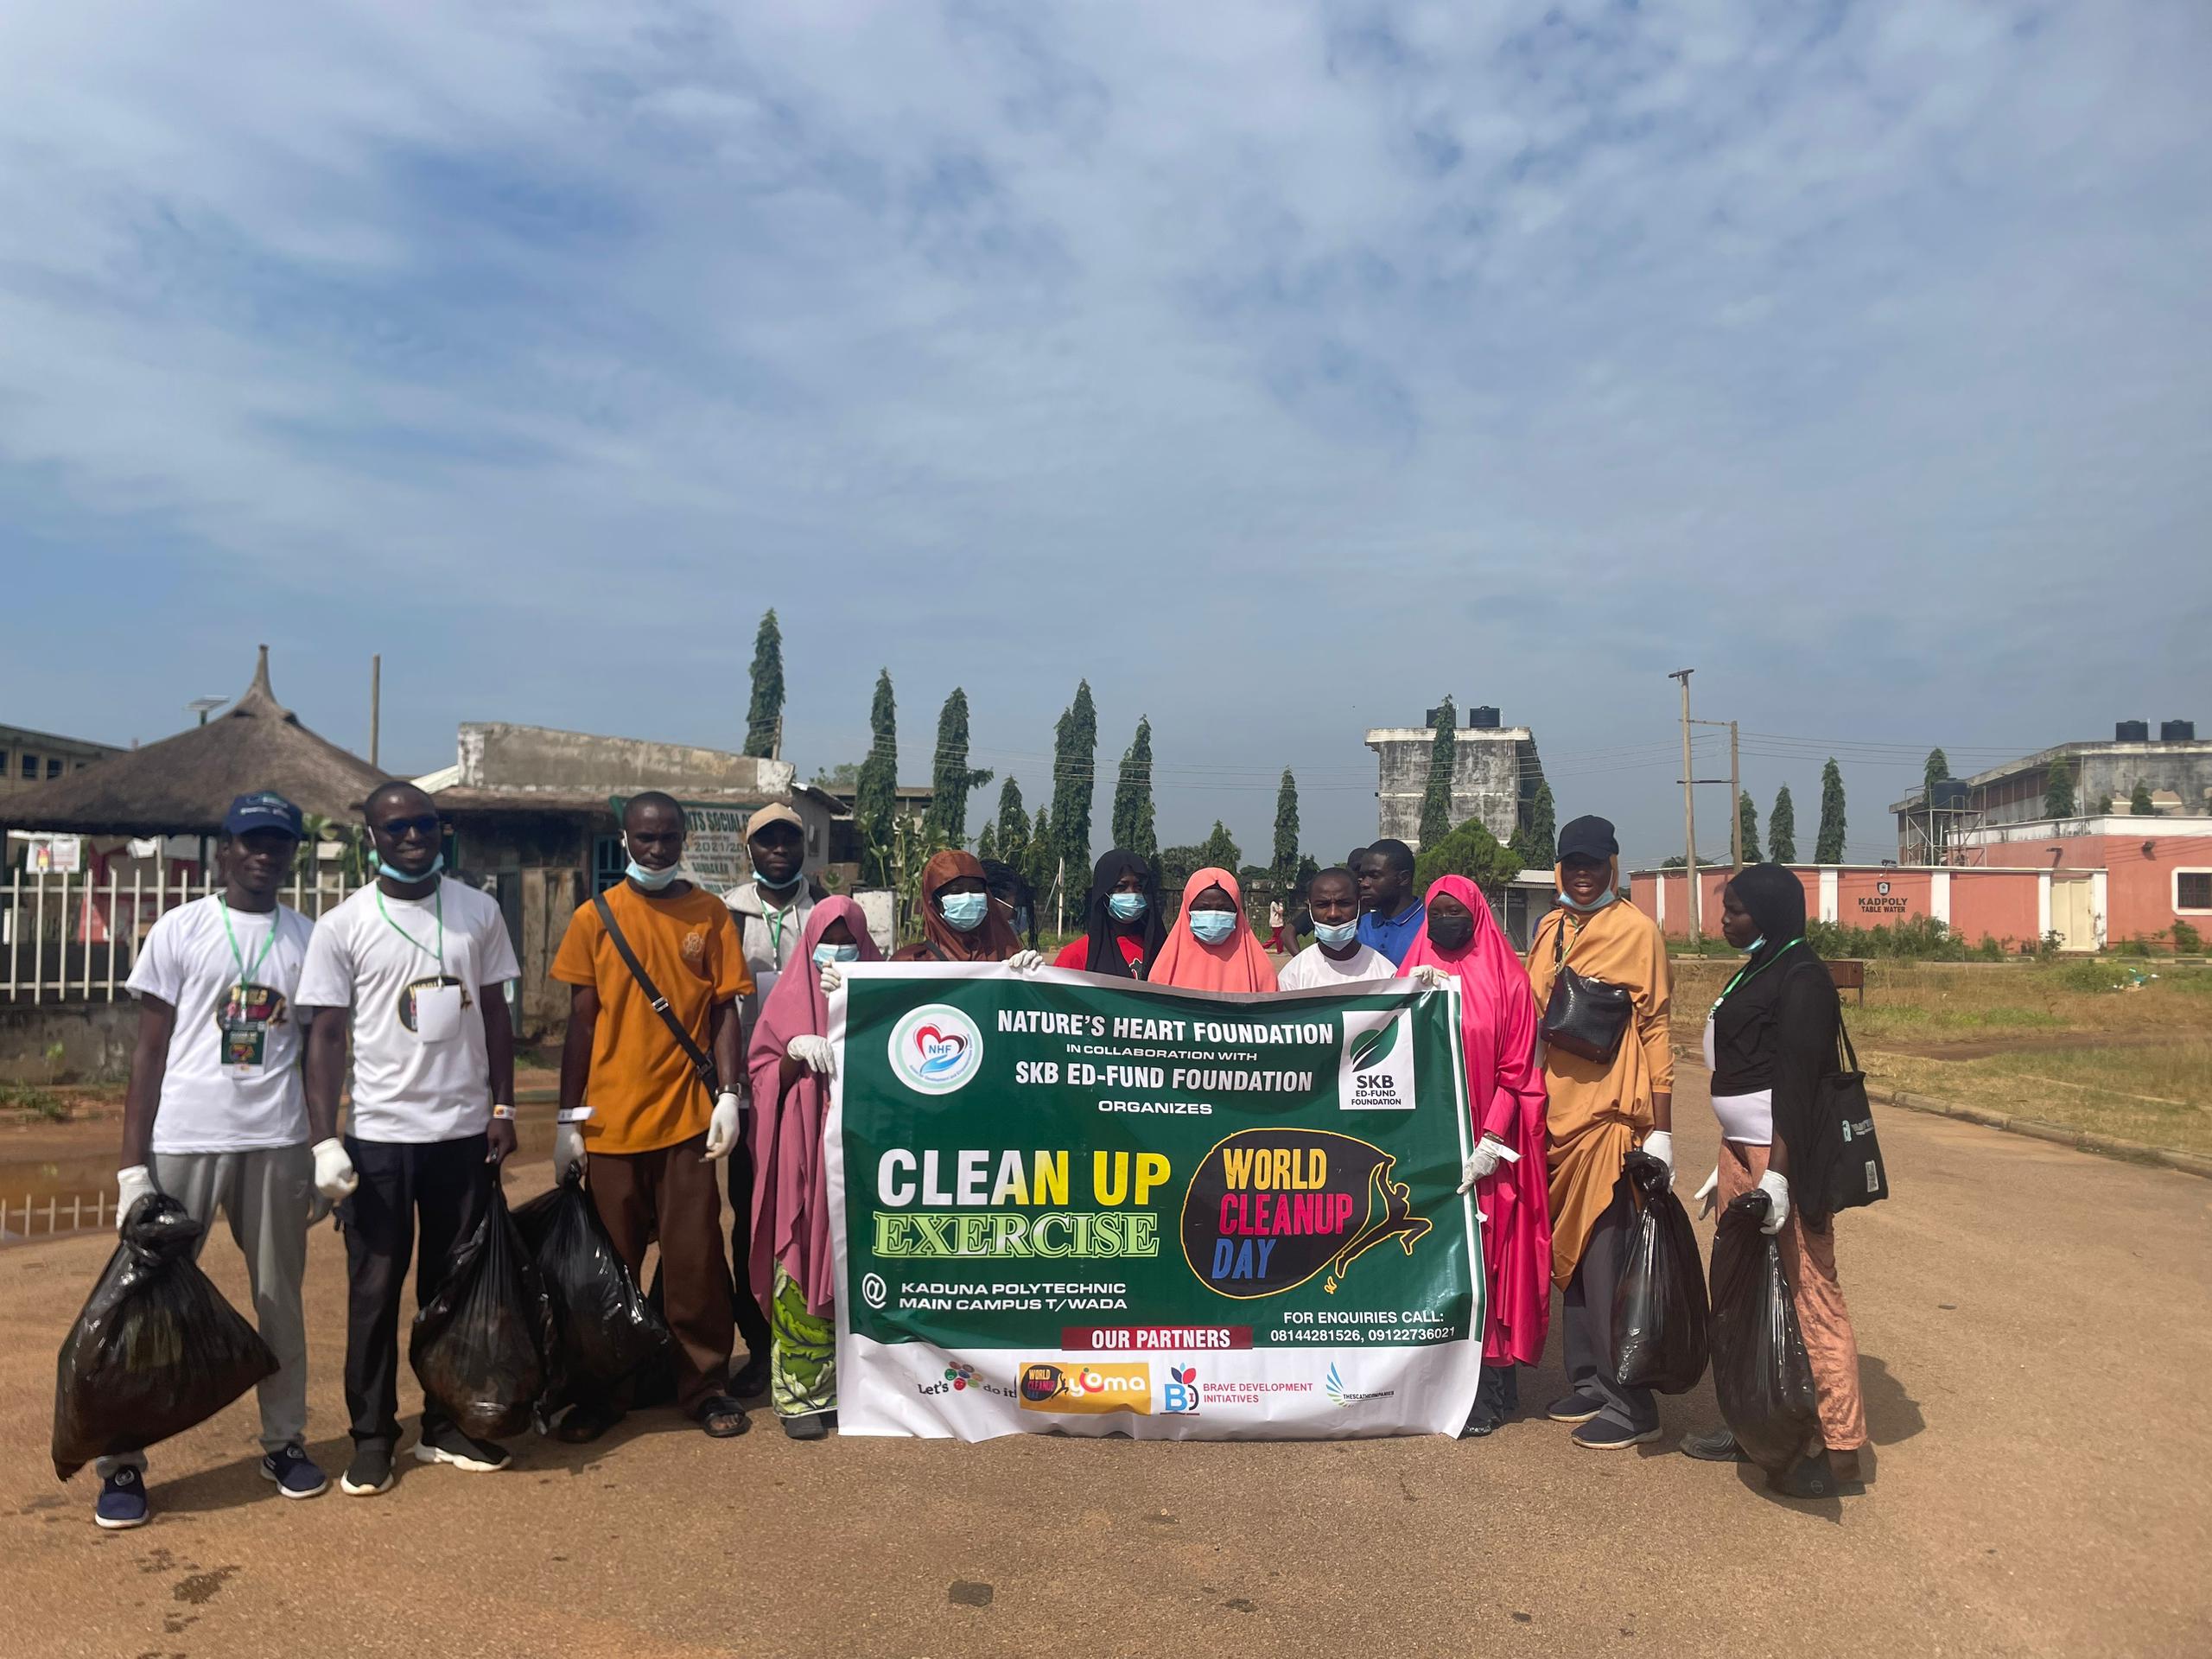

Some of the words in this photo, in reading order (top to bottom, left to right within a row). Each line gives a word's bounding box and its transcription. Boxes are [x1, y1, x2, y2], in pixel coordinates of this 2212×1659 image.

[706, 812, 742, 833] SOCIAL
[695, 842, 749, 853] 2021/20
[997, 1009, 1106, 1037] NATURE'S
[1113, 1017, 1186, 1041] HEART
[1193, 1022, 1333, 1045] FOUNDATION
[928, 1045, 952, 1054] NHF
[1066, 1044, 1081, 1053] IN
[1084, 1046, 1214, 1060] COLLABORATION
[1217, 1052, 1257, 1061] WITH
[1015, 1060, 1059, 1084] SKB
[1067, 1063, 1165, 1089] ED-FUND
[1172, 1068, 1313, 1092] FOUNDATION
[1357, 1074, 1394, 1089] SKB
[1098, 1100, 1213, 1115] ORGANIZES
[877, 1147, 1070, 1207] CLEAN
[1092, 1150, 1172, 1206] UP
[1223, 1148, 1327, 1191] WORLD
[1218, 1193, 1353, 1236] CLEANUP
[872, 1211, 1160, 1259] EXERCISE
[1211, 1238, 1276, 1280] DAY
[901, 1282, 988, 1295] KADUNA
[992, 1282, 1127, 1294] POLYTECHNIC
[899, 1298, 951, 1310] MAIN
[956, 1299, 1042, 1310] CAMPUS
[1046, 1298, 1128, 1312] T/WADA
[1283, 1312, 1314, 1324] FOR
[1318, 1312, 1398, 1324] ENQUIRIES
[1402, 1311, 1445, 1323] CALL:
[1091, 1330, 1130, 1348] OUR
[1136, 1329, 1231, 1348] PARTNERS
[1270, 1329, 1365, 1343] 08144281526,
[1368, 1326, 1456, 1341] 09122736021
[1028, 1369, 1051, 1381] WORLD
[917, 1380, 950, 1395] Let's
[982, 1383, 1001, 1395] do
[1203, 1382, 1236, 1392] BRAVE
[1239, 1382, 1313, 1392] DEVELOPMENT
[1204, 1394, 1260, 1403] INITIATIVES
